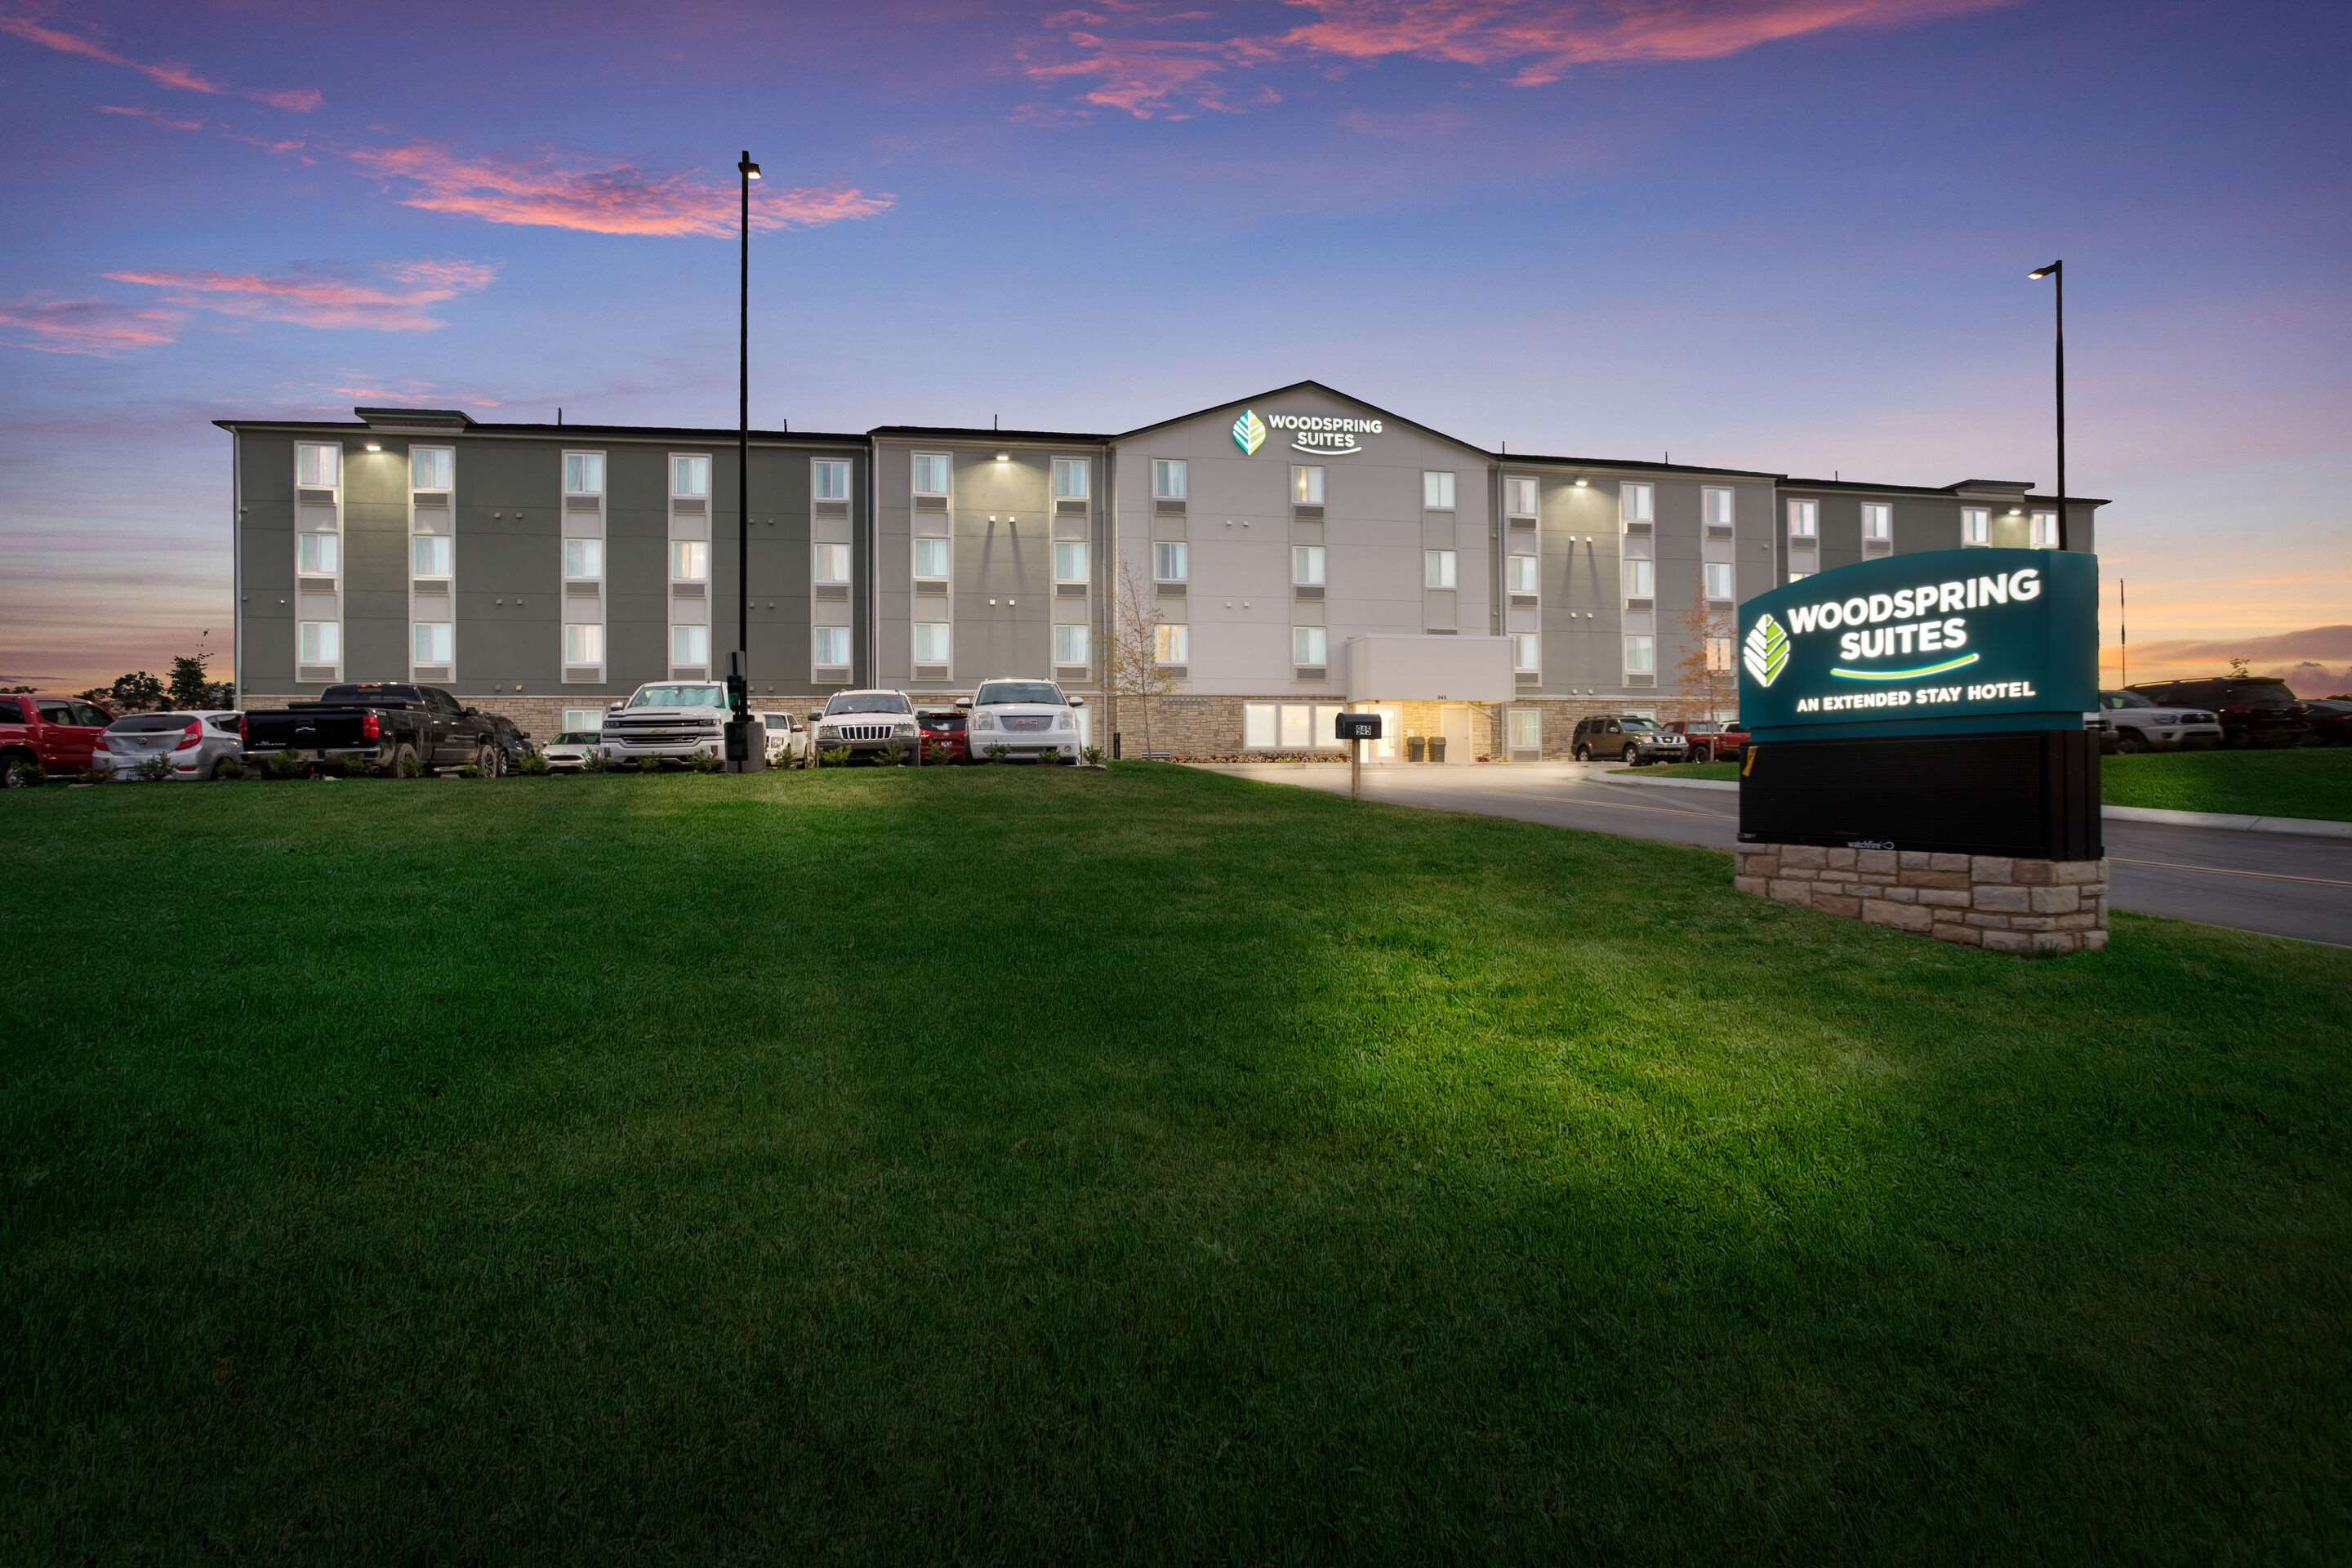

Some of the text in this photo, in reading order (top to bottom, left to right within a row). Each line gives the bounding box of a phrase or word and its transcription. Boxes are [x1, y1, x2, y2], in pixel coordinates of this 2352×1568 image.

[1268, 414, 1383, 434] WOODSPRING
[1297, 432, 1355, 447] SUITES
[1788, 568, 2041, 635] WOODSPRING
[1839, 617, 1967, 660] SUITES
[1797, 681, 2036, 712] AN EXTENDED STAY HOTEL
[1356, 725, 1371, 735] 945
